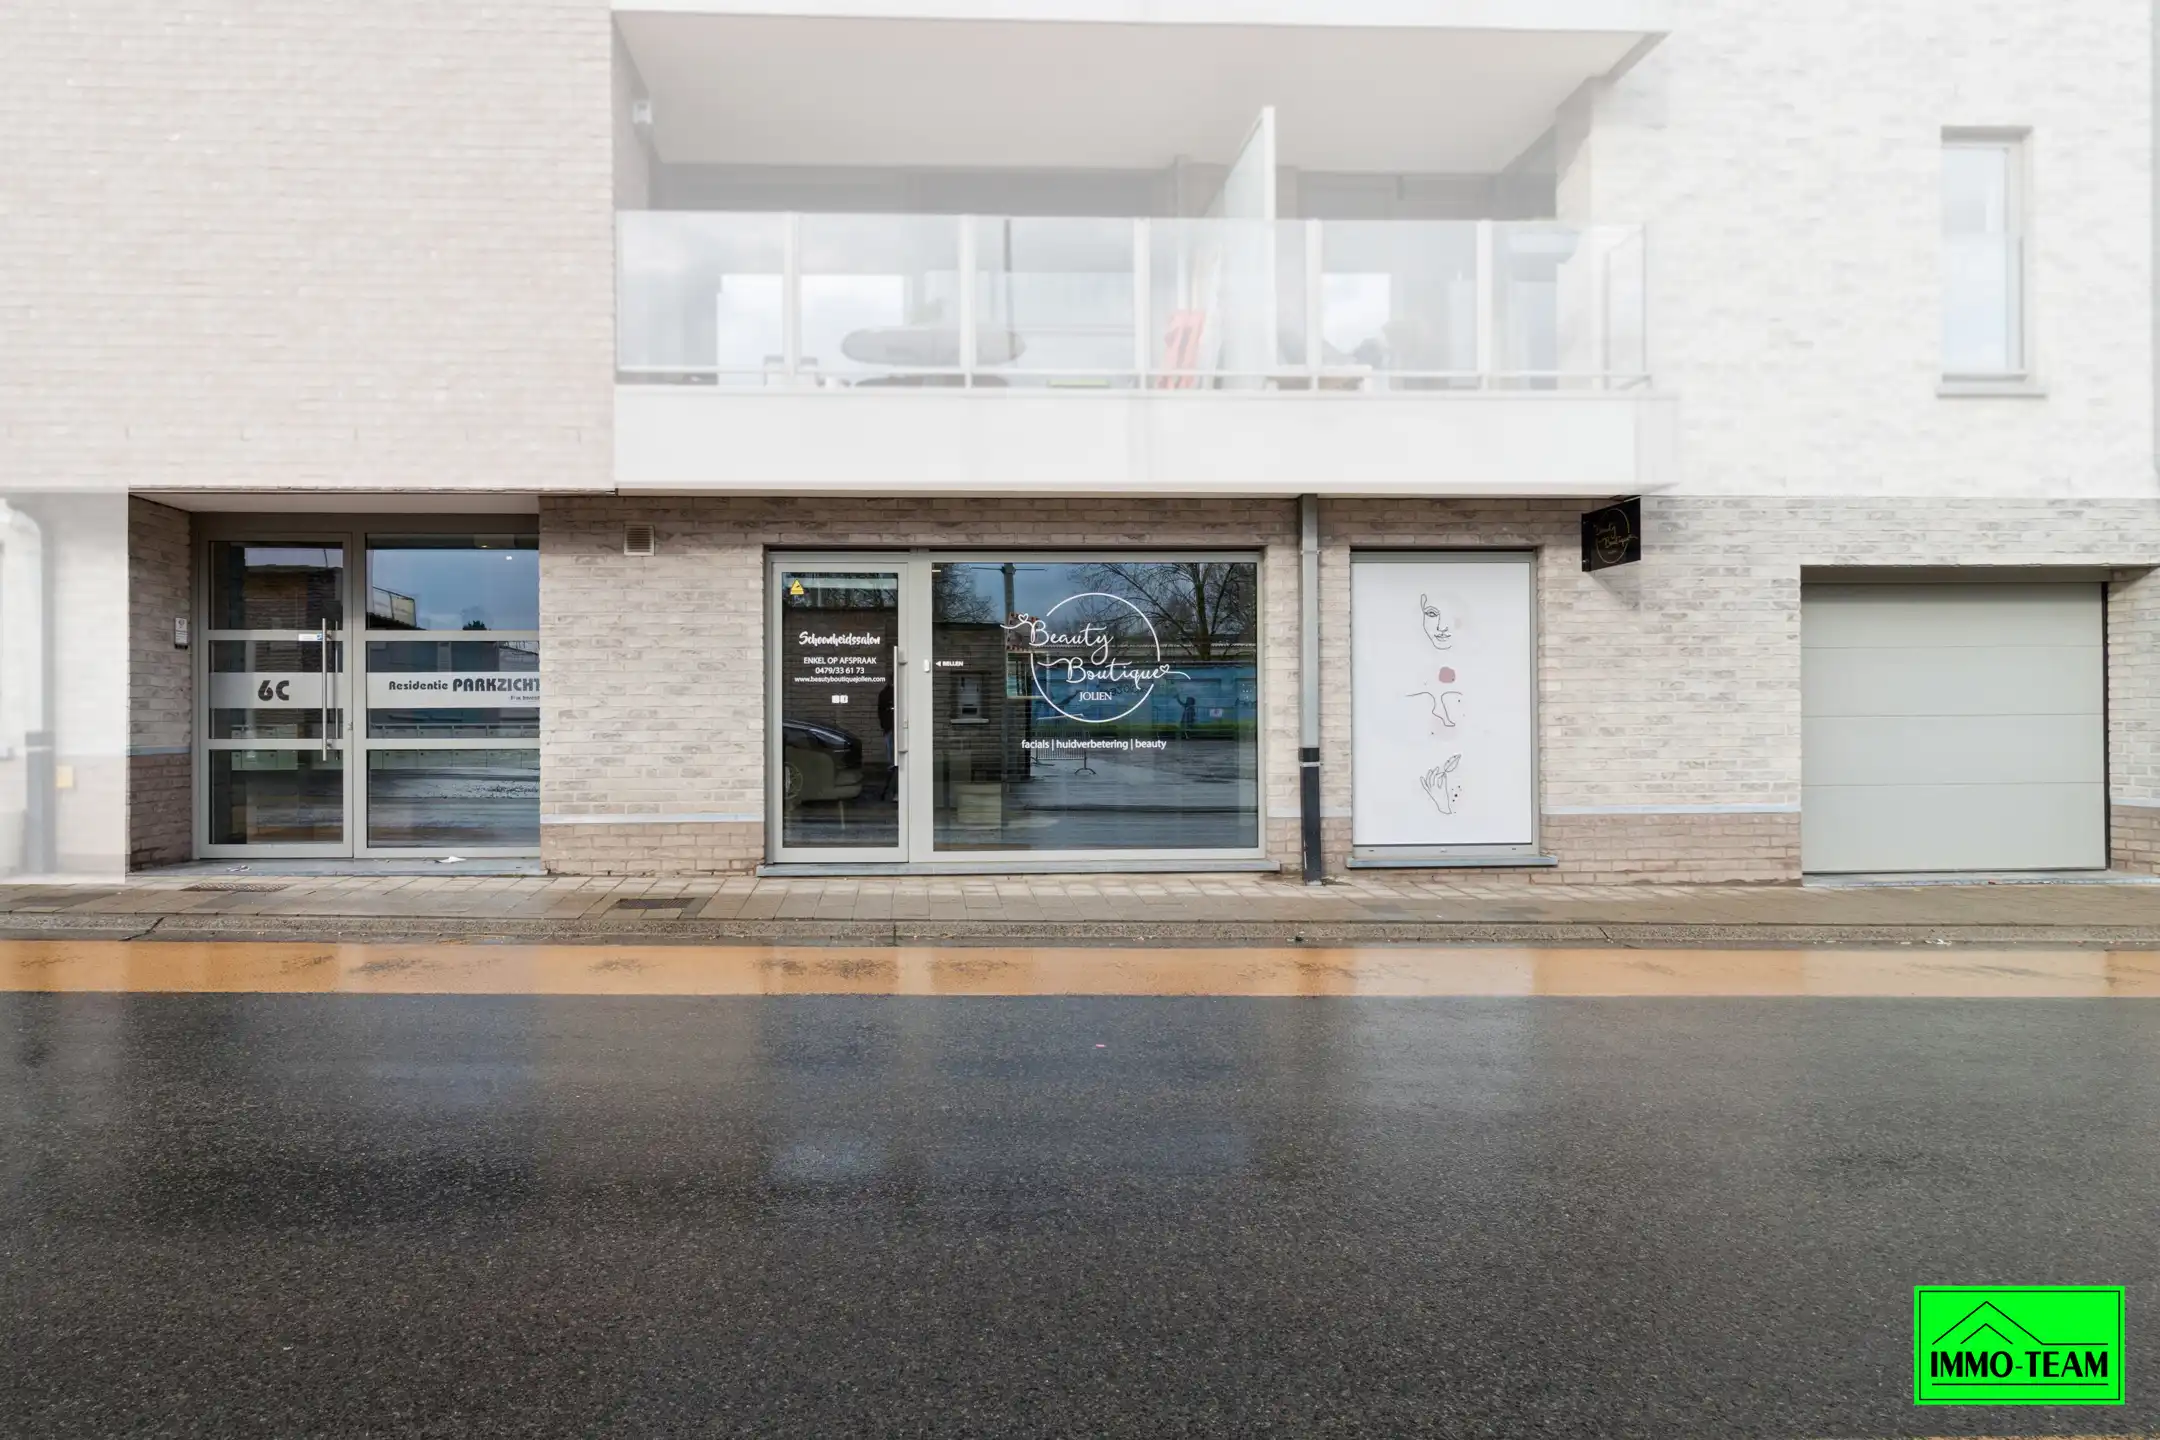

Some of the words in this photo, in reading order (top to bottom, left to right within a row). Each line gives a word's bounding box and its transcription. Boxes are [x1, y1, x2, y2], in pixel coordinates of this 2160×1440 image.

[799, 631, 881, 646] Schoonheidssalon
[1022, 619, 1114, 666] Beauty
[803, 656, 827, 665] ENKEL
[827, 656, 839, 665] OP
[839, 656, 877, 665] AFSPRAAK
[1040, 656, 1162, 690] Boutique
[257, 679, 290, 702] 6C
[388, 681, 449, 691] Residentie
[1079, 691, 1112, 701] JOLIEN
[1021, 739, 1050, 749] facials
[1056, 739, 1129, 750] huidverbetering
[1135, 739, 1167, 750] beauty
